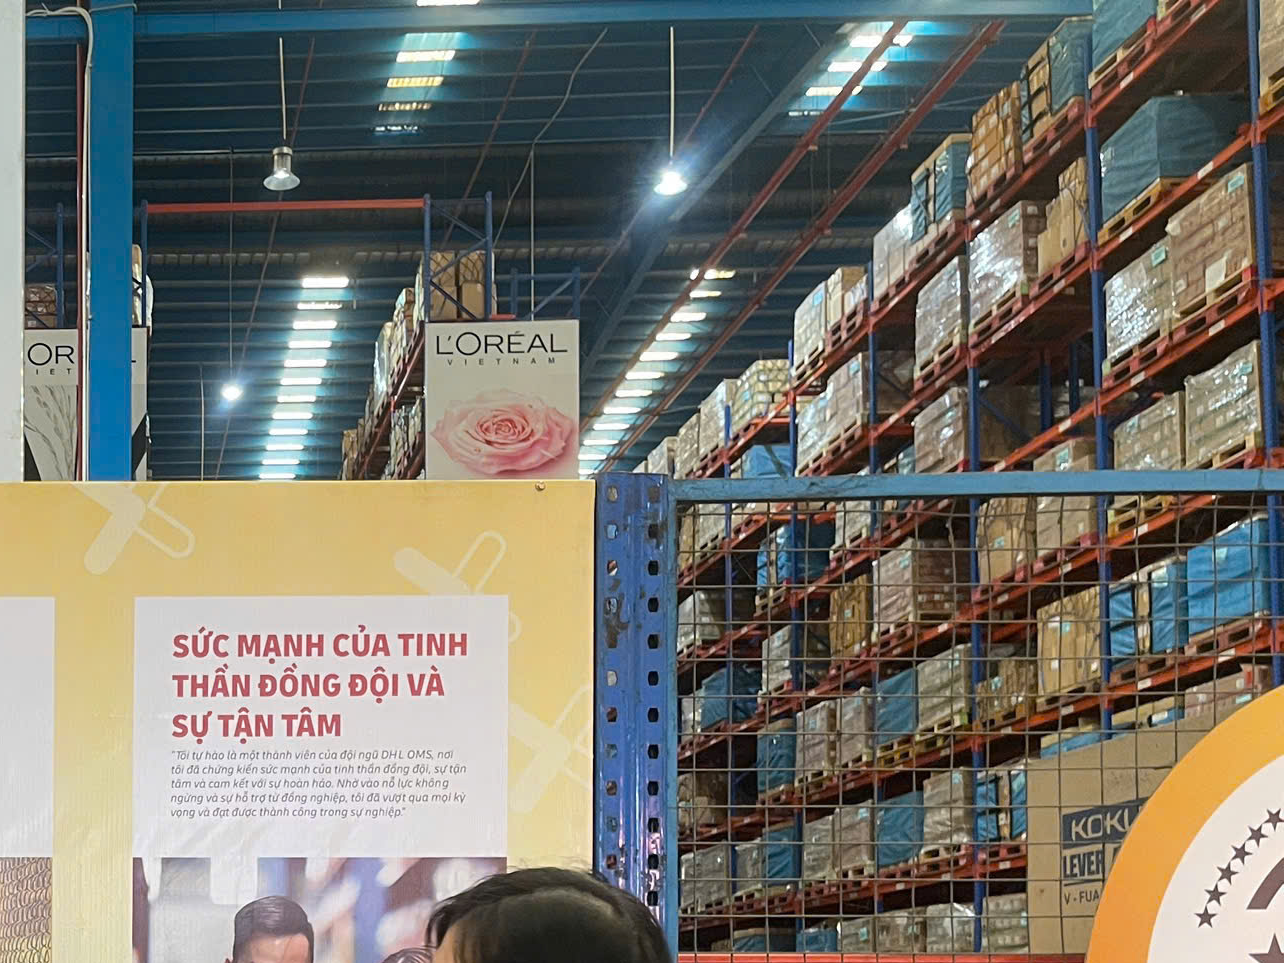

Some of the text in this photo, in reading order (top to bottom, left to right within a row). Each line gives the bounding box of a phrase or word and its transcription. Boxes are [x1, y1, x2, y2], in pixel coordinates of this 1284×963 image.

[437, 331, 567, 355] L'ORÉAL
[447, 357, 555, 366] VIETNAM
[173, 625, 467, 664] SỨC MẠNH CỦA TINH
[172, 663, 444, 703] THẦN ĐỒNG ĐỘI VÀ
[172, 707, 340, 744] SỰ TẬN TÂM
